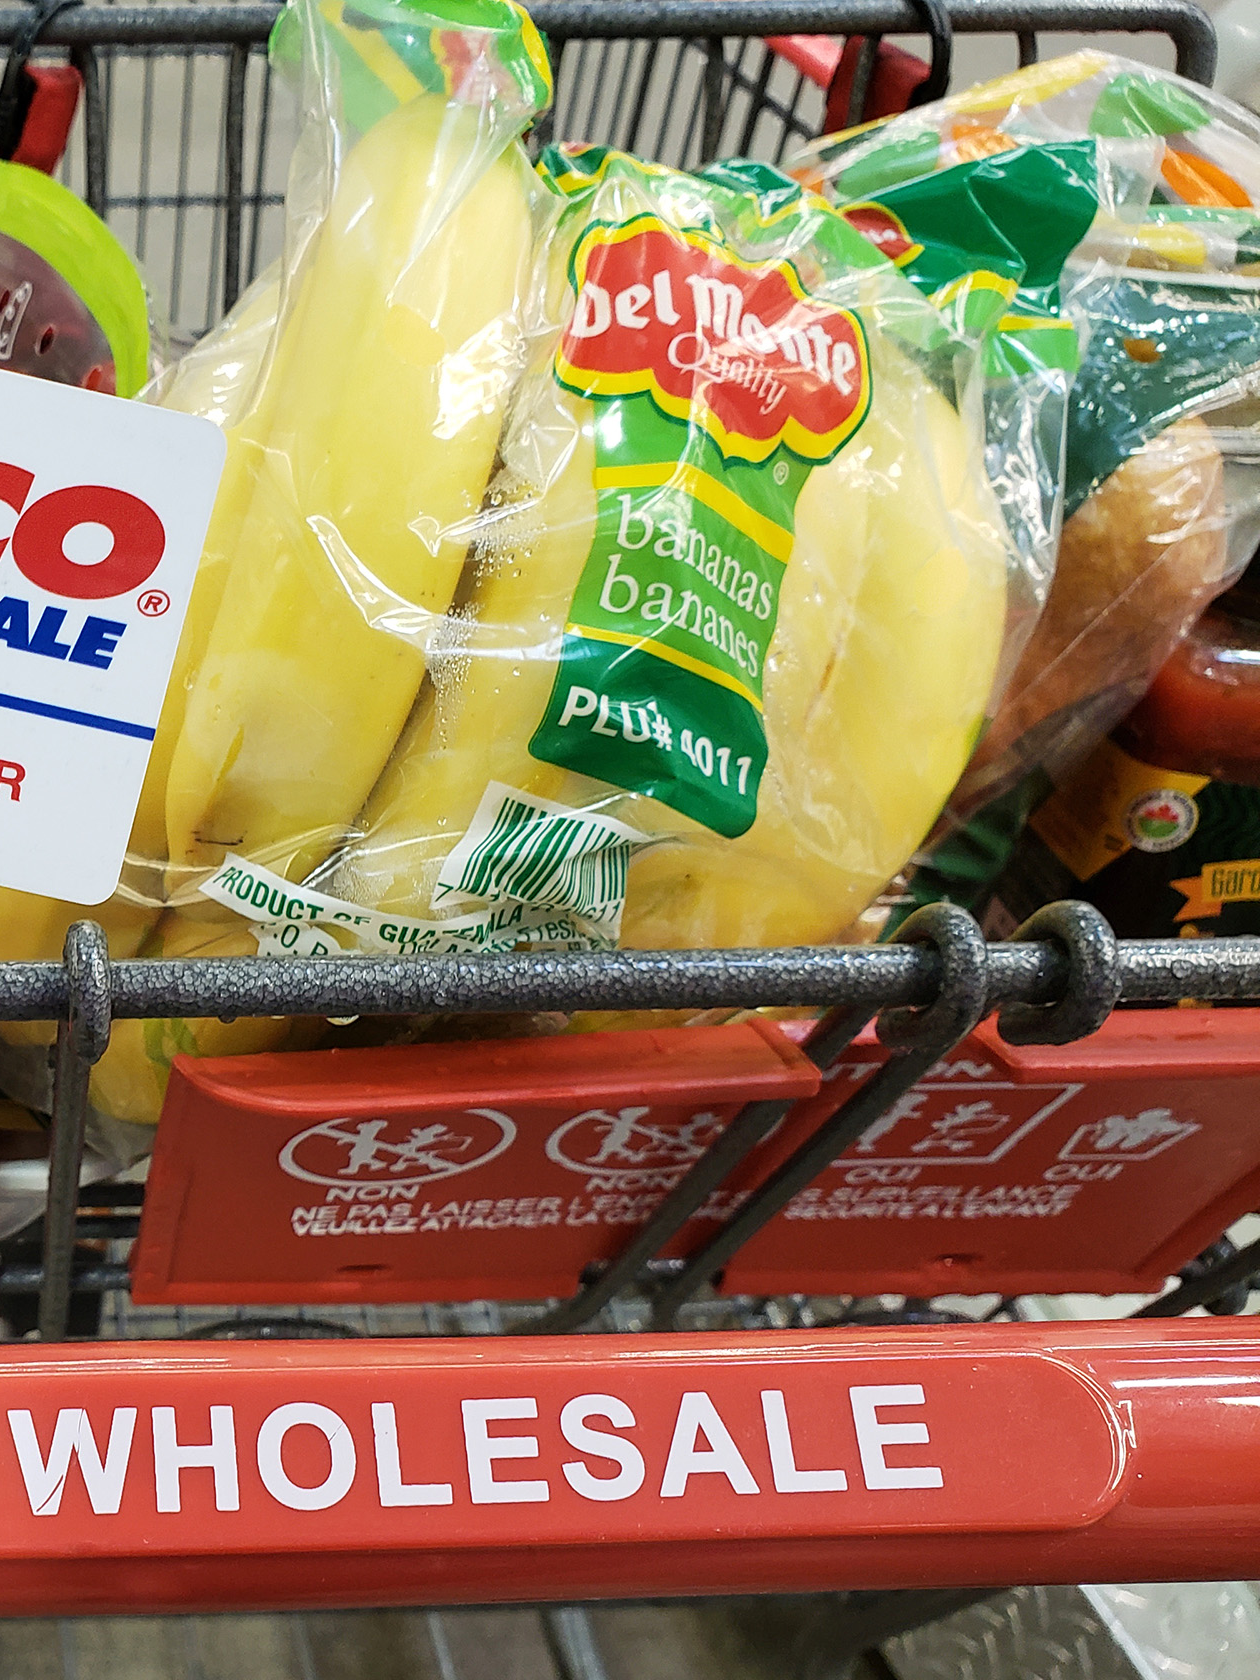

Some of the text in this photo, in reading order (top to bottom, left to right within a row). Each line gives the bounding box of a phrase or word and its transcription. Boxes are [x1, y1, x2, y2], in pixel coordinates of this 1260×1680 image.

[569, 270, 856, 396] Del Monte
[667, 331, 787, 414] Quality
[616, 494, 773, 620] bananas
[599, 553, 758, 678] bananes
[557, 685, 753, 796] PLU# 4011
[212, 866, 324, 921] PRODUCT
[326, 1184, 420, 1202] NON
[586, 1175, 681, 1192] NON
[845, 1166, 922, 1184] OUI
[1042, 1163, 1124, 1180] OUI
[291, 1205, 340, 1221] NE
[347, 1202, 413, 1219] PAS
[7, 1384, 943, 1516] WHOLESALE
